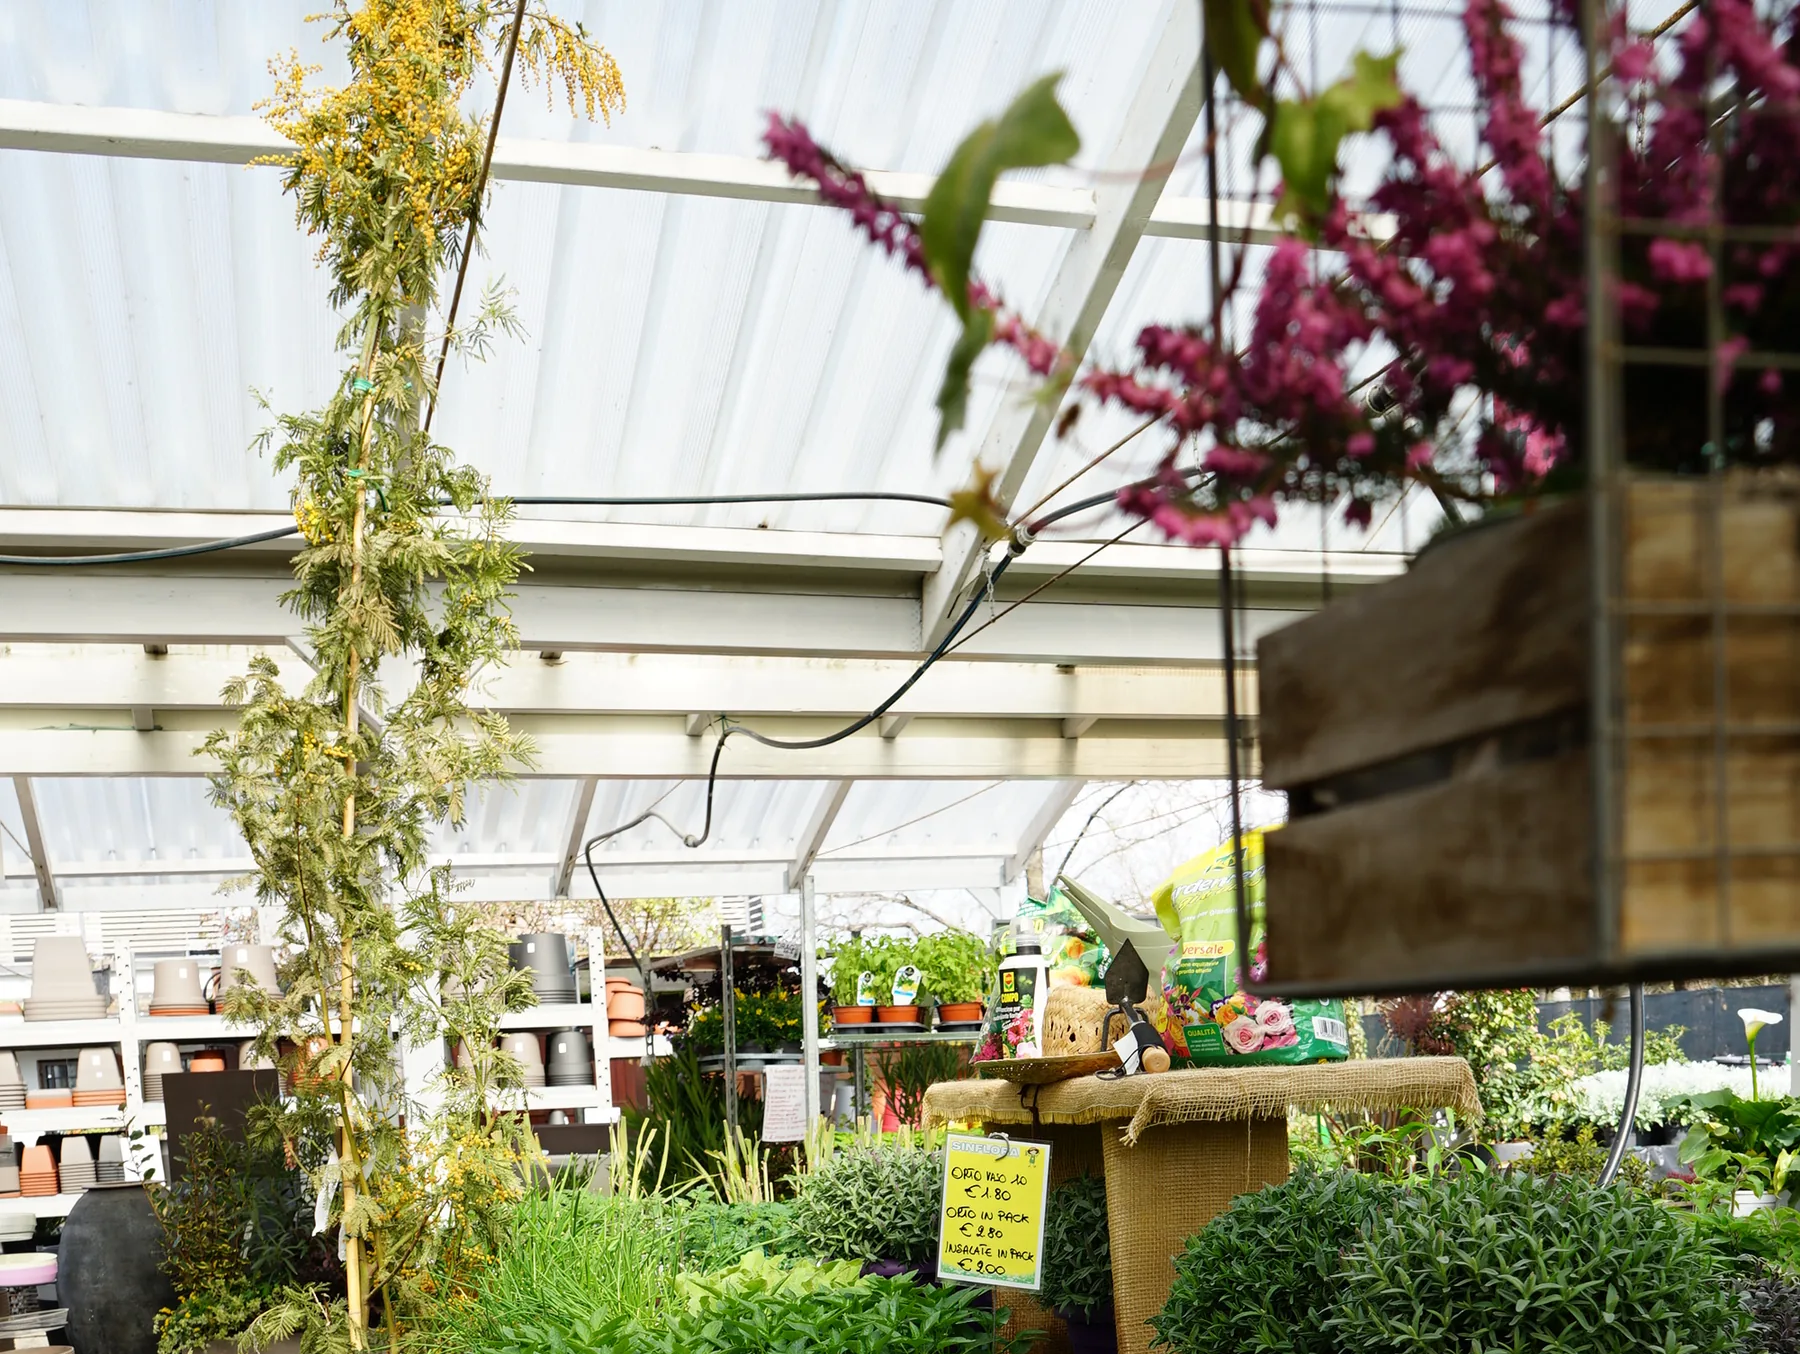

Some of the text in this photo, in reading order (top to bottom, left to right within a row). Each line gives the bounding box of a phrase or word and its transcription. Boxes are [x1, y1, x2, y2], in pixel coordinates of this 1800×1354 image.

[1001, 992, 1019, 1003] COMPO
[1187, 1026, 1217, 1037] QUALITÀ
[951, 1141, 1020, 1158] SINFLORA
[951, 1166, 1028, 1185] ORTO VASO 10
[946, 1206, 1030, 1224] ORTO IN PACK
[945, 1241, 1034, 1262] INSALATE IN PACK
